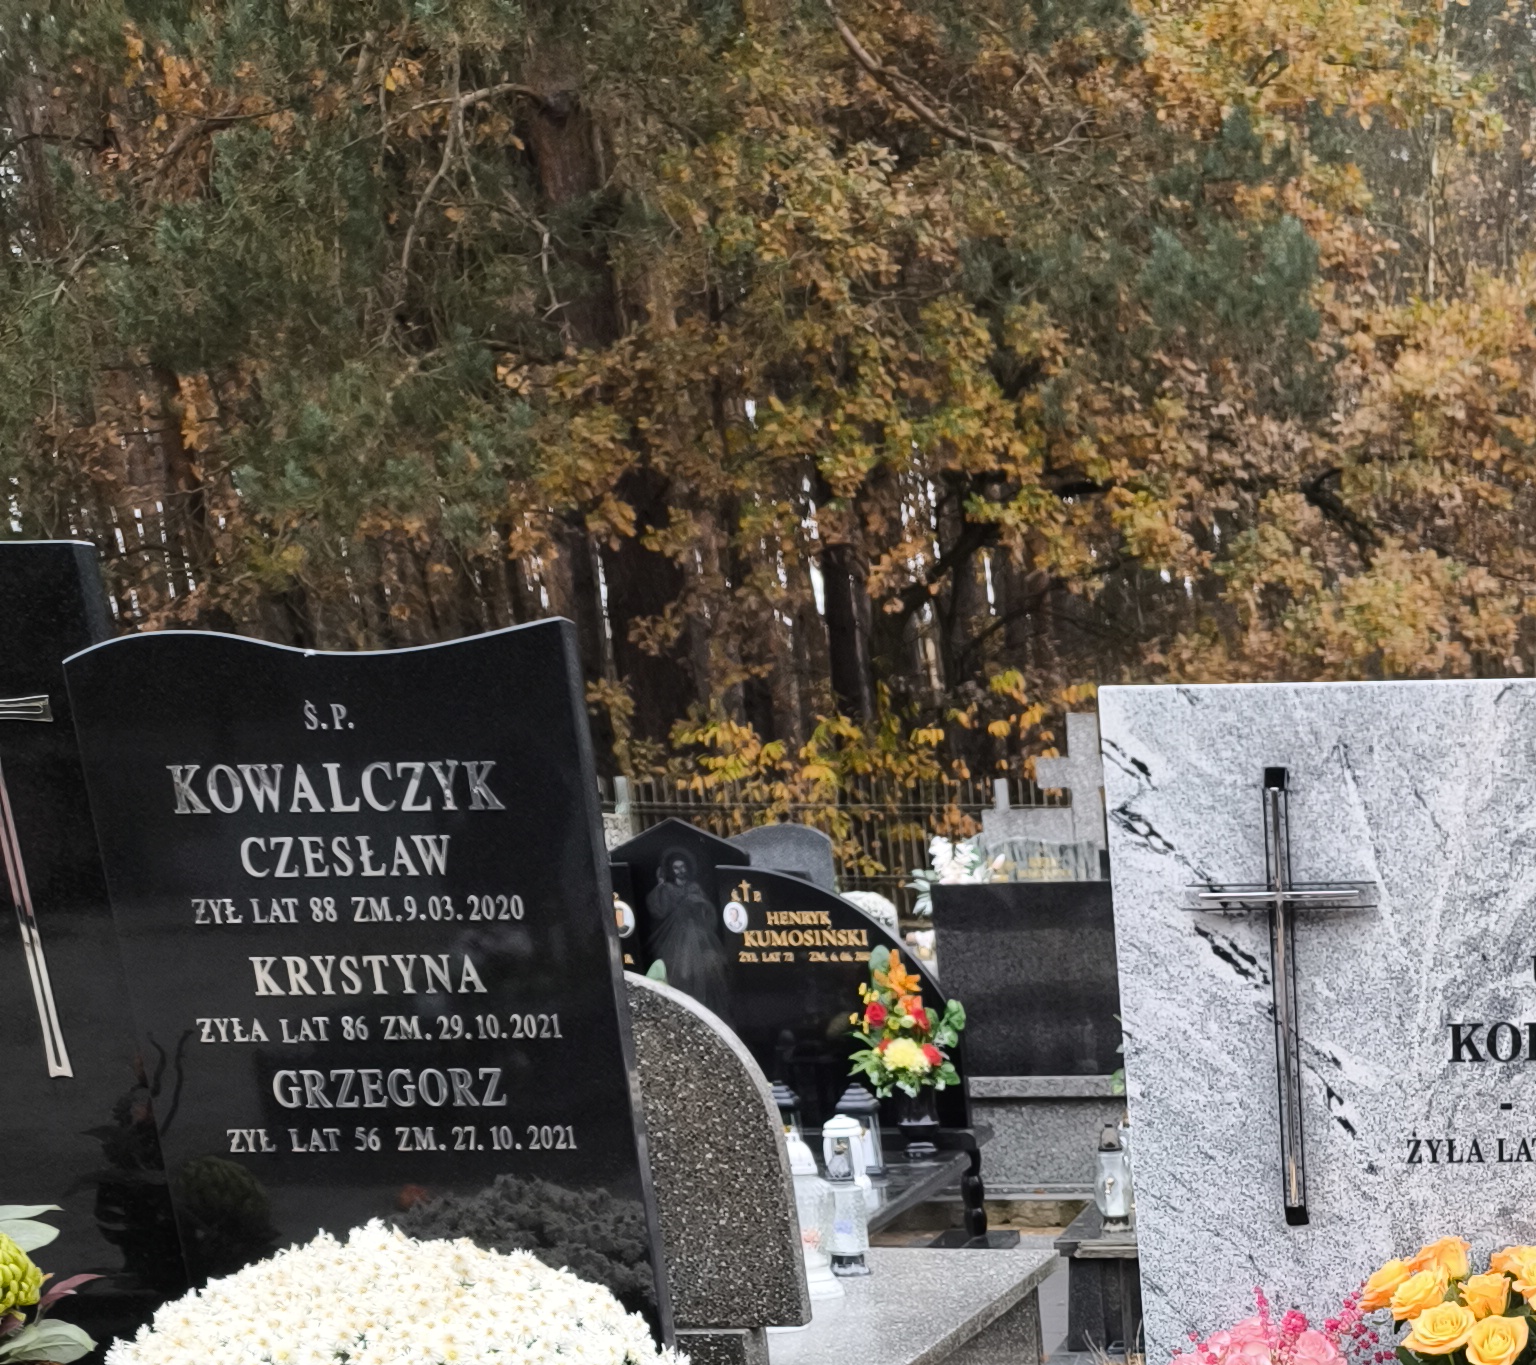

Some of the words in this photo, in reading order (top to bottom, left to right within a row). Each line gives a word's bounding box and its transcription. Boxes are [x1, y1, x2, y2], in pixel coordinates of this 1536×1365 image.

[166, 759, 506, 814] KOWALCZYK
[240, 834, 451, 878] CZESŁAW
[251, 898, 299, 923] LAT
[310, 897, 338, 922] 88
[766, 910, 832, 926] HENRYK
[248, 954, 488, 996] KRYSTYNA
[279, 1016, 330, 1043] LAT
[341, 1015, 369, 1041] 86
[272, 1067, 508, 1109] GRZEGORZ
[287, 1127, 341, 1152] LAT
[354, 1127, 381, 1152] 56
[1406, 1131, 1485, 1165] ŻYŁA
